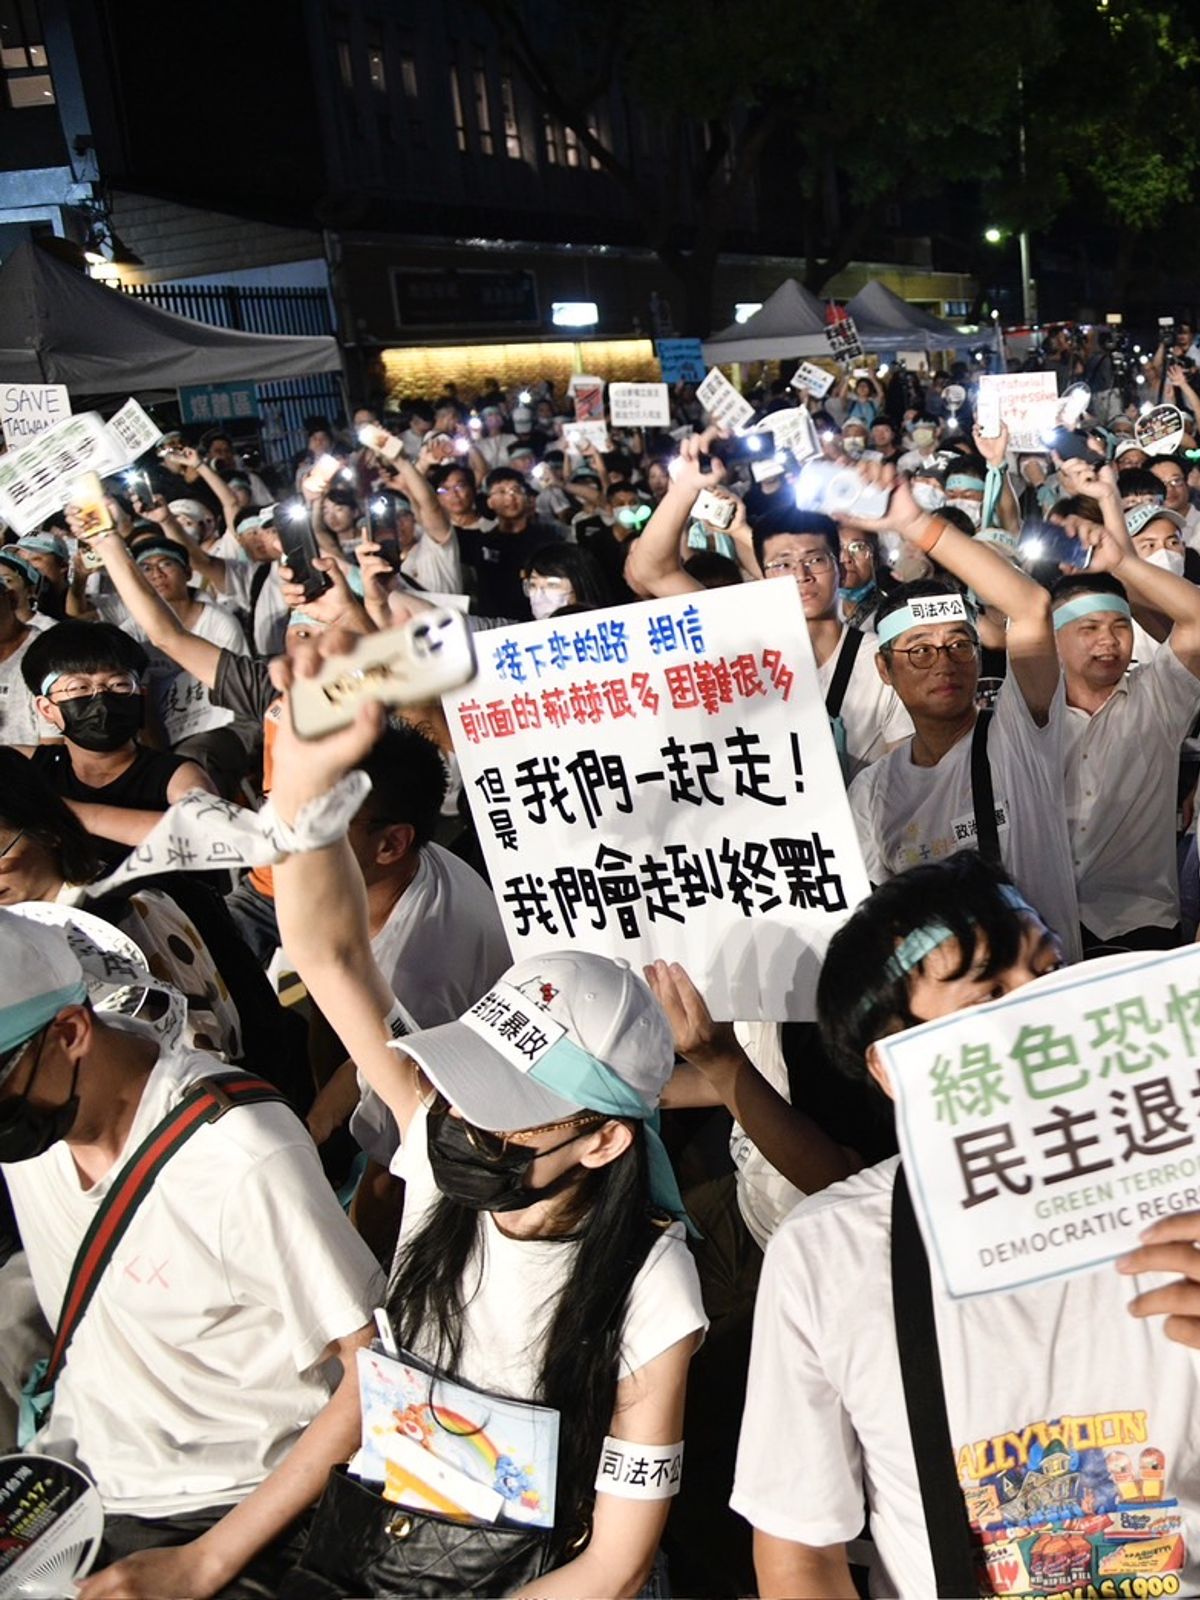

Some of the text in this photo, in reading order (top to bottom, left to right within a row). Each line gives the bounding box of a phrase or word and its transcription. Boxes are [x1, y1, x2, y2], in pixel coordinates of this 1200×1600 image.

[4, 388, 60, 413] SAVE
[911, 601, 964, 619] 司法不公
[664, 649, 795, 716] 困難很多
[475, 767, 519, 852] 但是
[503, 832, 849, 940] 我們會走到終點
[472, 992, 548, 1061] 對抗暴政
[1034, 1182, 1115, 1220] GREEN
[979, 1201, 1131, 1268] DEMOCRATIC
[602, 1448, 681, 1488] 司法不公
[1118, 1574, 1181, 1599] 1900
